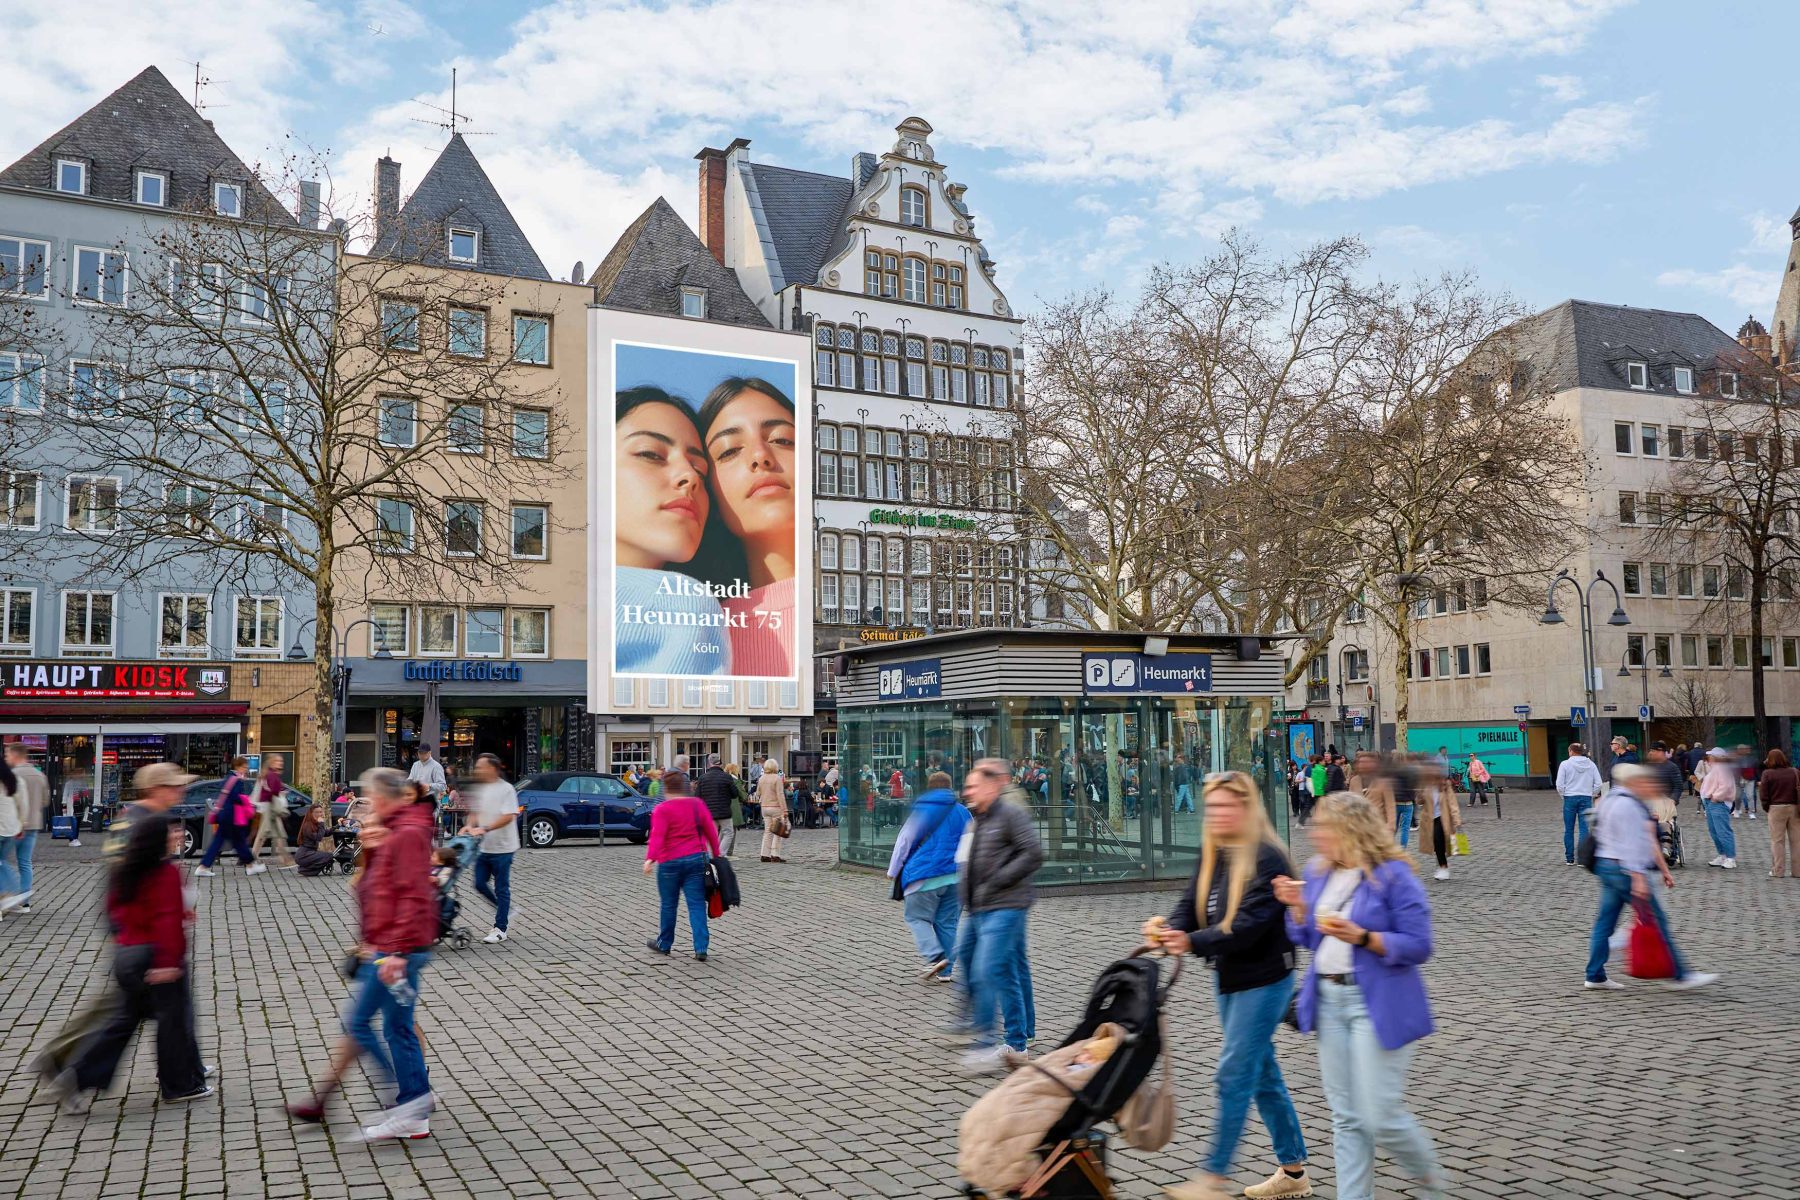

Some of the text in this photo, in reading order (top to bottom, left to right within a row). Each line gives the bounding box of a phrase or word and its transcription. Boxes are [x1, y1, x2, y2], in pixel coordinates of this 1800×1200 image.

[657, 576, 751, 598] Altstadt
[623, 605, 782, 629] Heumarkt 75
[693, 642, 720, 655] Köln
[14, 664, 189, 688] HAUPT KIOSK
[404, 660, 457, 681] Gaffel
[906, 672, 938, 687] Heumarkt
[1144, 666, 1207, 680] Heumarkt
[1478, 731, 1518, 742] SPIELHALLE
